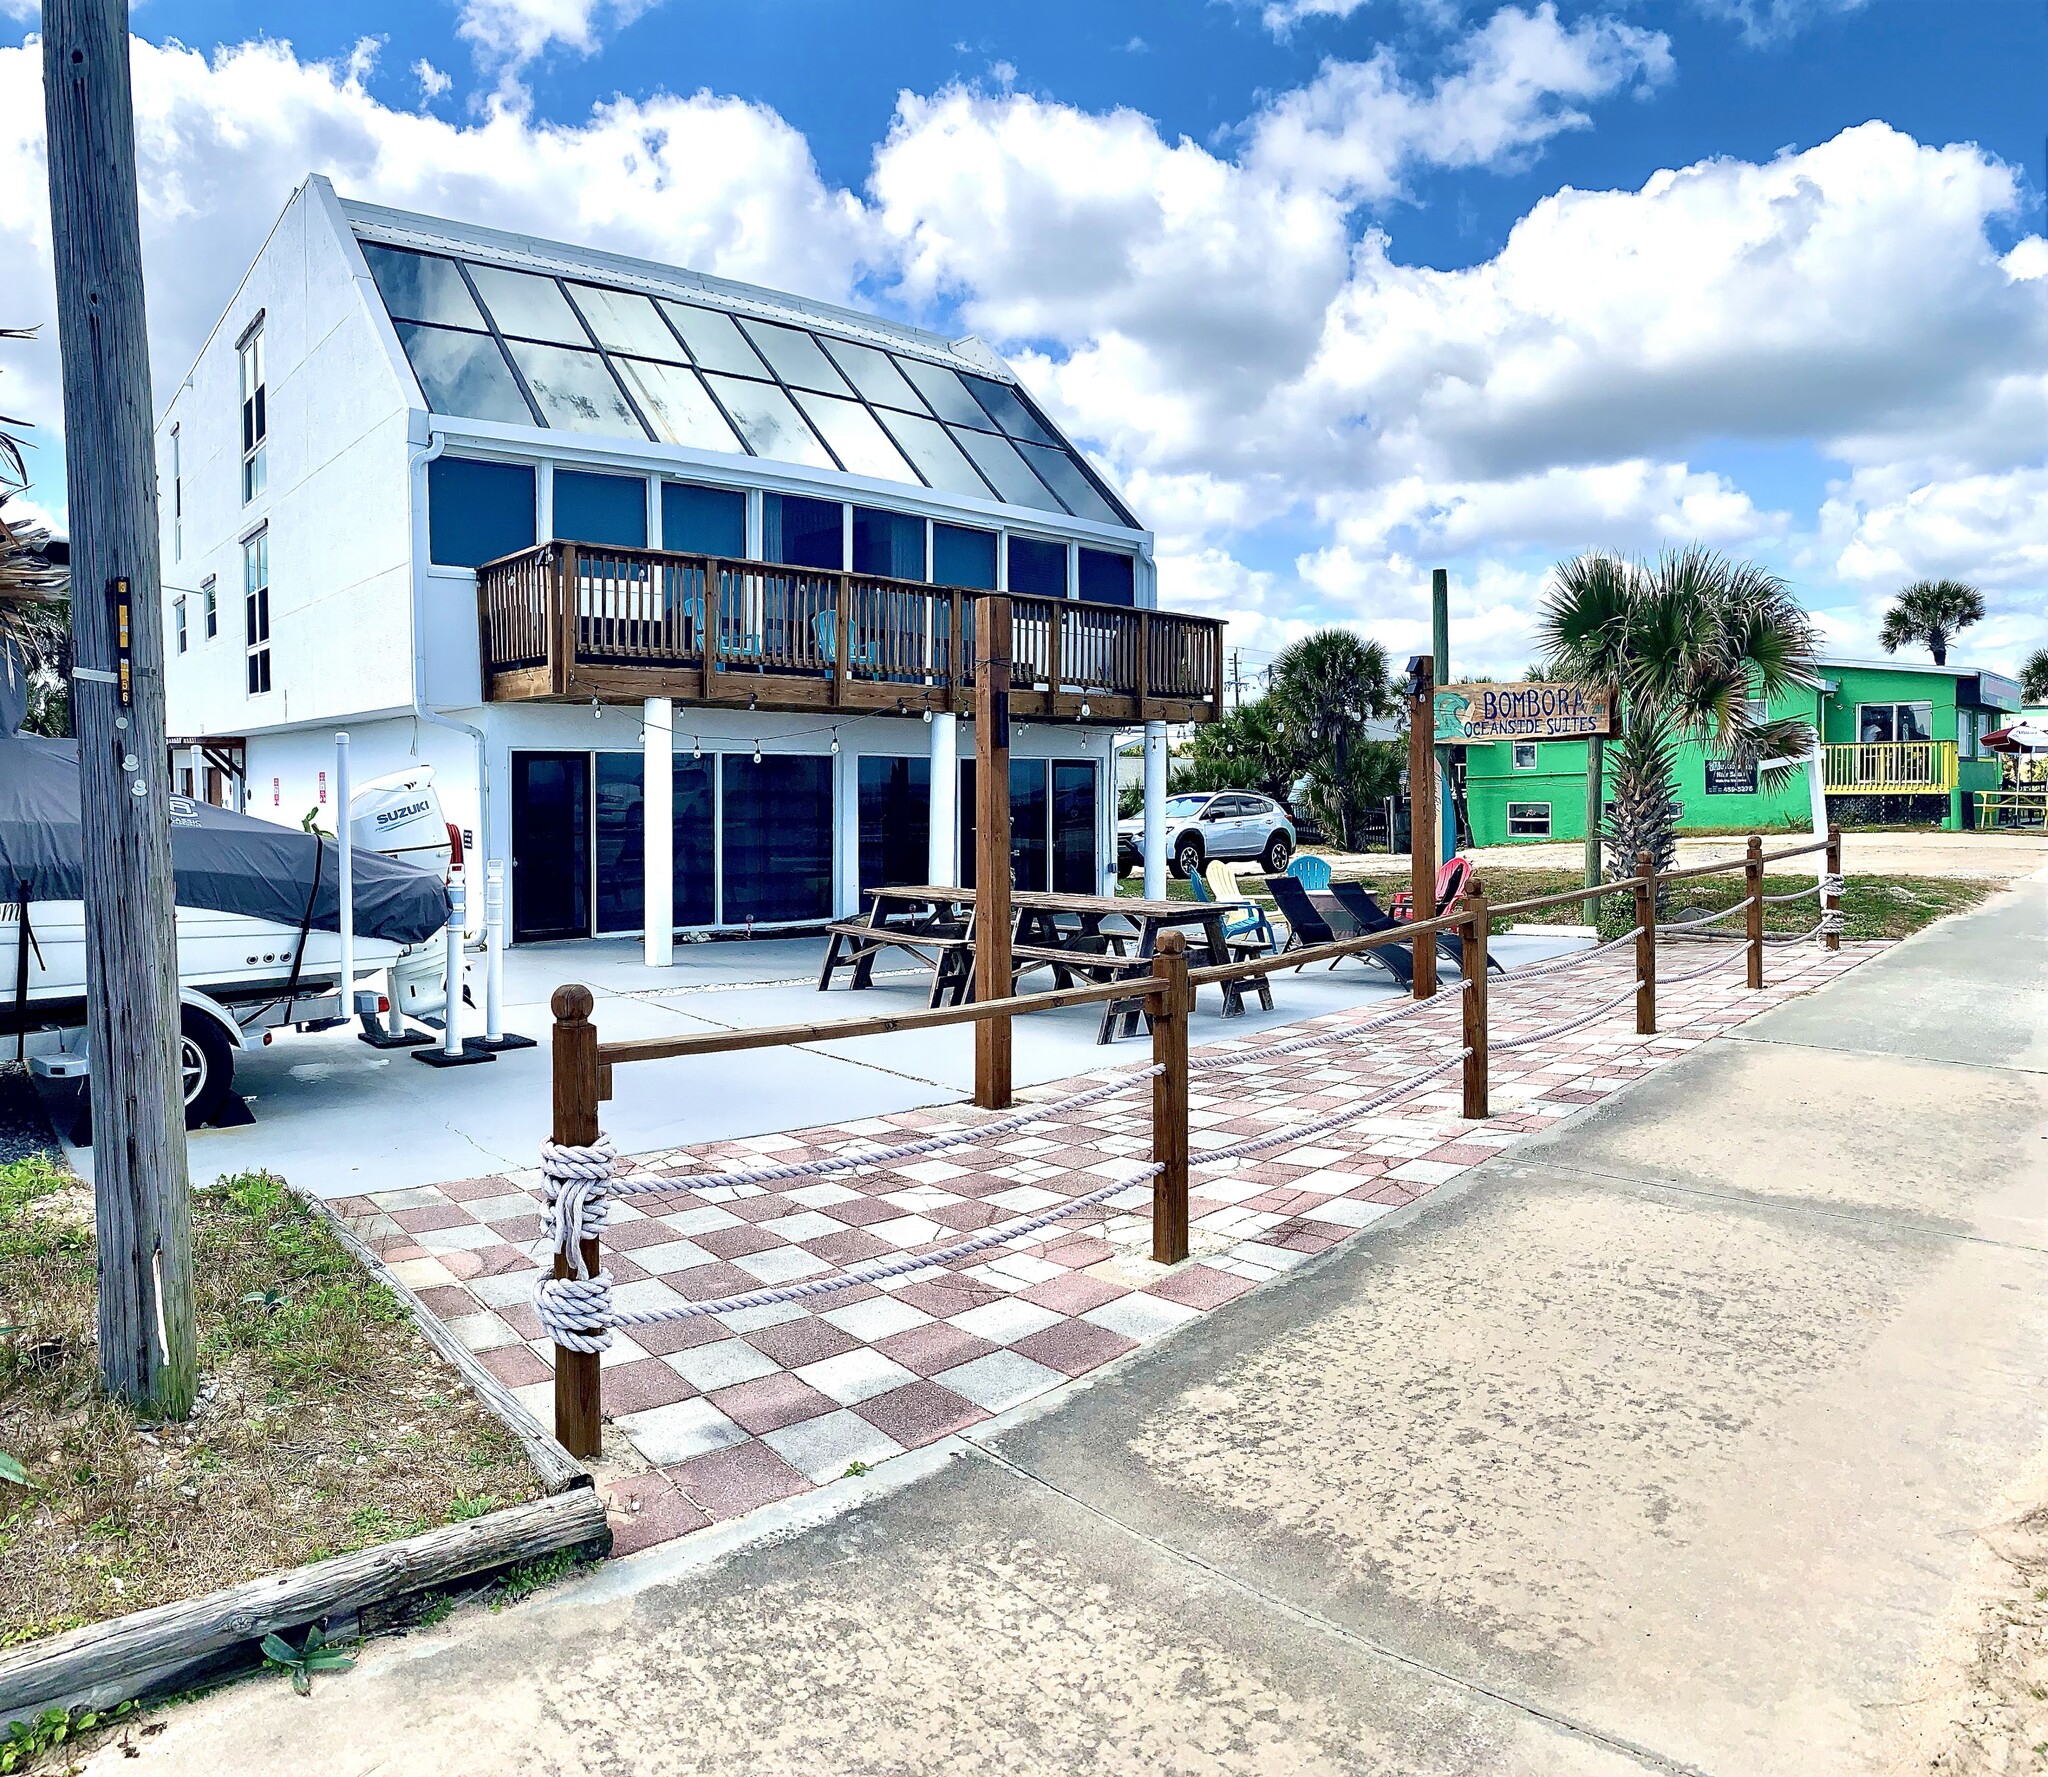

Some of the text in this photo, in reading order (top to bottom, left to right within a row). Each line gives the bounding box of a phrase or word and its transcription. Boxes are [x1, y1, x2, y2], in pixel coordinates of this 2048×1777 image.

[1483, 689, 1585, 719] BOMBORA
[1464, 716, 1597, 738] OCEANSIDE SUITES
[376, 800, 429, 824] SUZUKI
